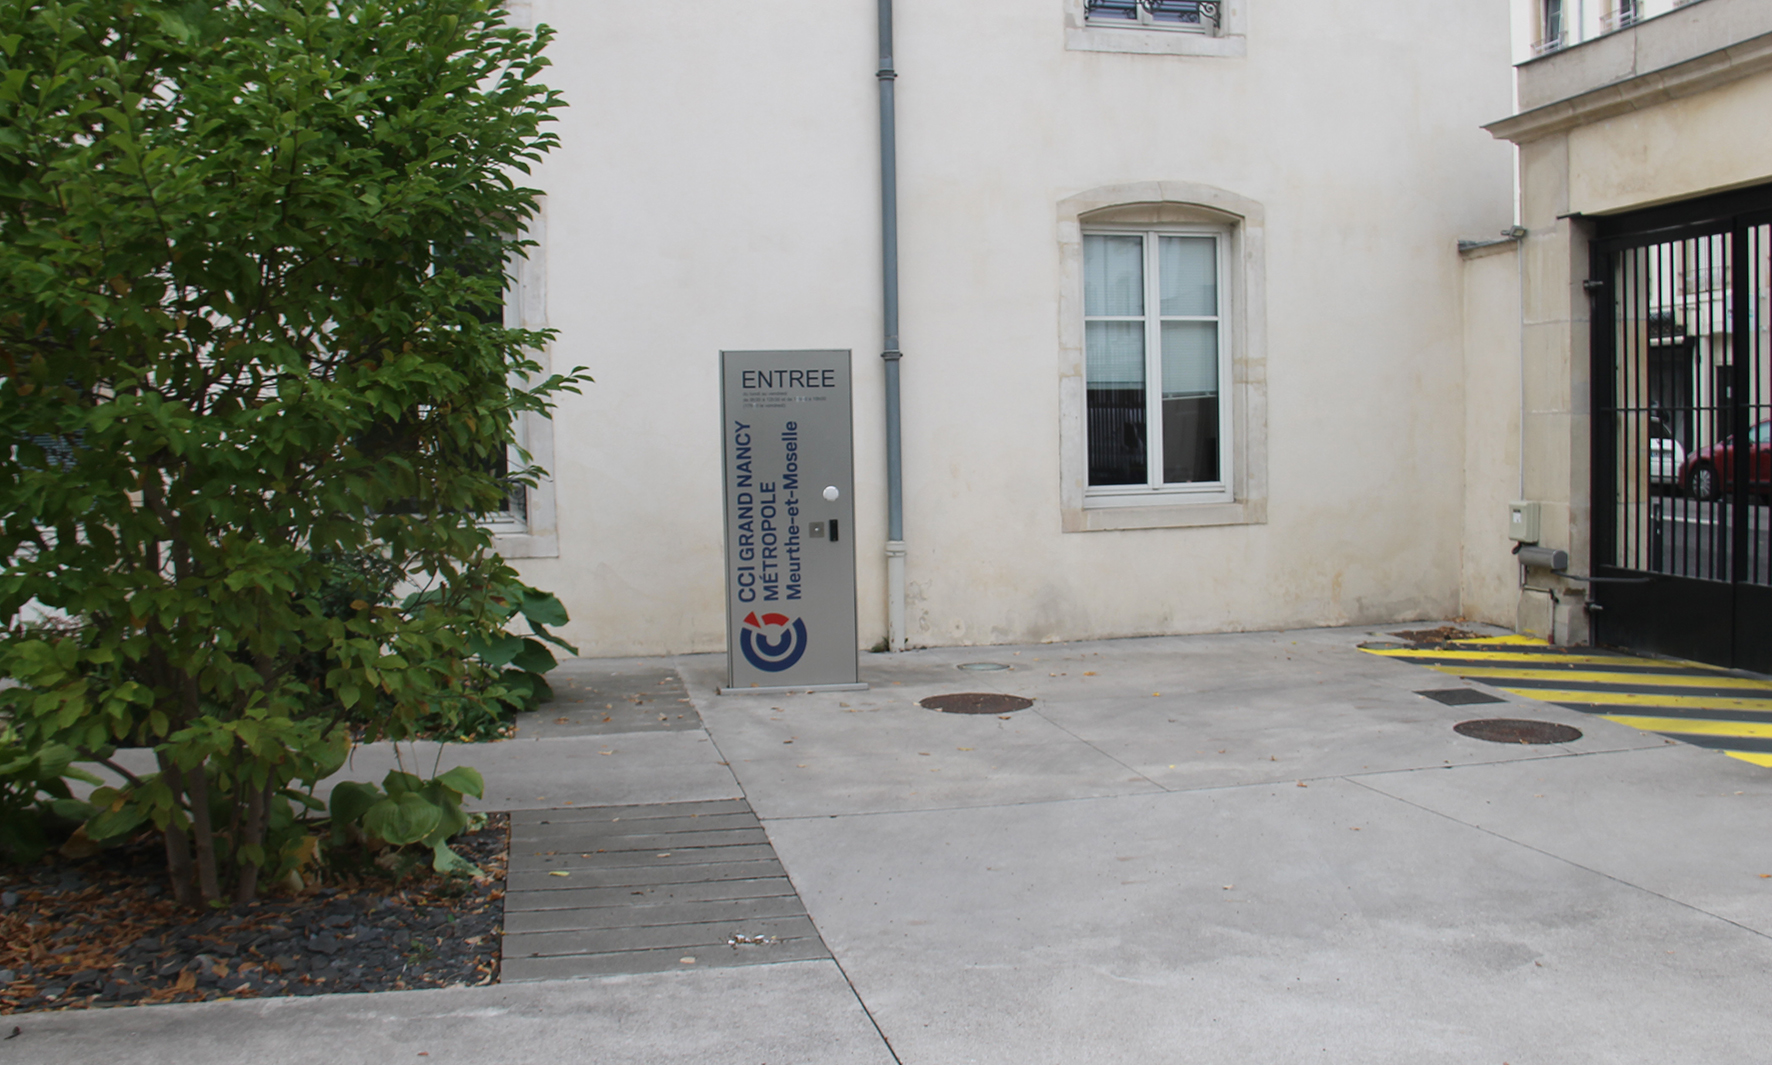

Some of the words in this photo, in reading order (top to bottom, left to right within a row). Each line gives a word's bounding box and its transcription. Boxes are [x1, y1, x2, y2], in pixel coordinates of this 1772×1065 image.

[742, 369, 836, 389] ENTREE
[734, 420, 753, 488] NANCY
[737, 492, 755, 562] GRAND
[759, 481, 779, 602] MÉTROPOLE
[781, 420, 802, 601] Meurthe-et-Moselle
[737, 565, 756, 603] CCI
